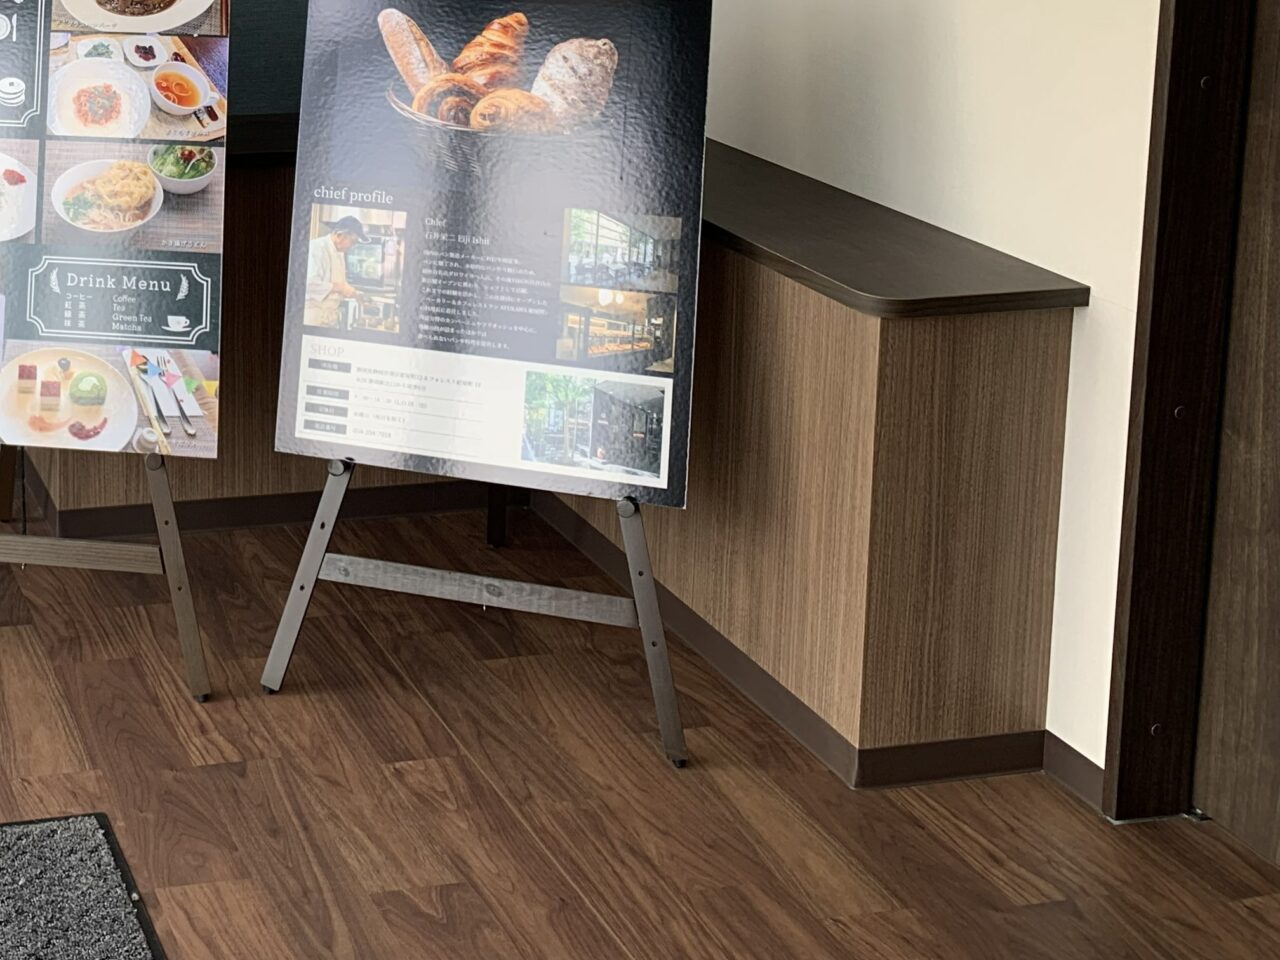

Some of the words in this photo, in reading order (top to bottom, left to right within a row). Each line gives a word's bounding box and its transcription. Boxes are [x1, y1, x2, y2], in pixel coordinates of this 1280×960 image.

[314, 185, 348, 200] chief
[349, 189, 394, 205] profile
[67, 272, 116, 289] Drink
[122, 275, 171, 292] Menu
[112, 294, 136, 304] Coffee
[112, 304, 126, 312] Tea
[112, 313, 138, 322] Green
[139, 314, 152, 323] Tea
[111, 322, 142, 331] Matcha
